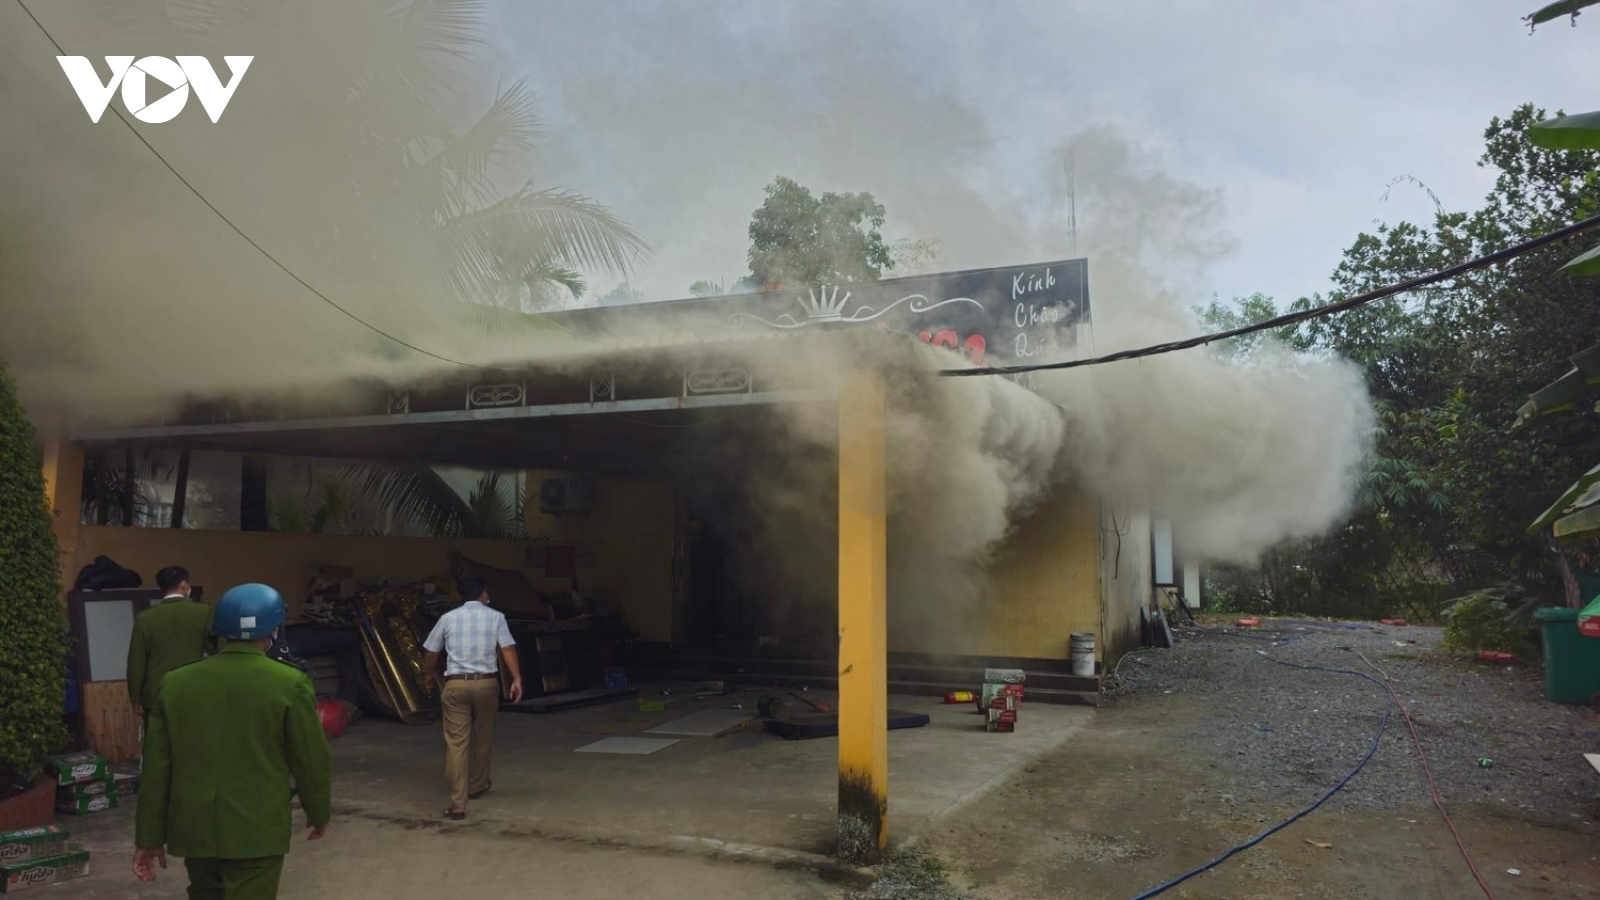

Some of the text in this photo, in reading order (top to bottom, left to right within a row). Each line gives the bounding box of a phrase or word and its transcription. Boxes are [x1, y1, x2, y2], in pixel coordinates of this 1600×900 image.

[1012, 268, 1056, 299] Kính
[0, 844, 28, 859] uda
[21, 867, 55, 884] huda
